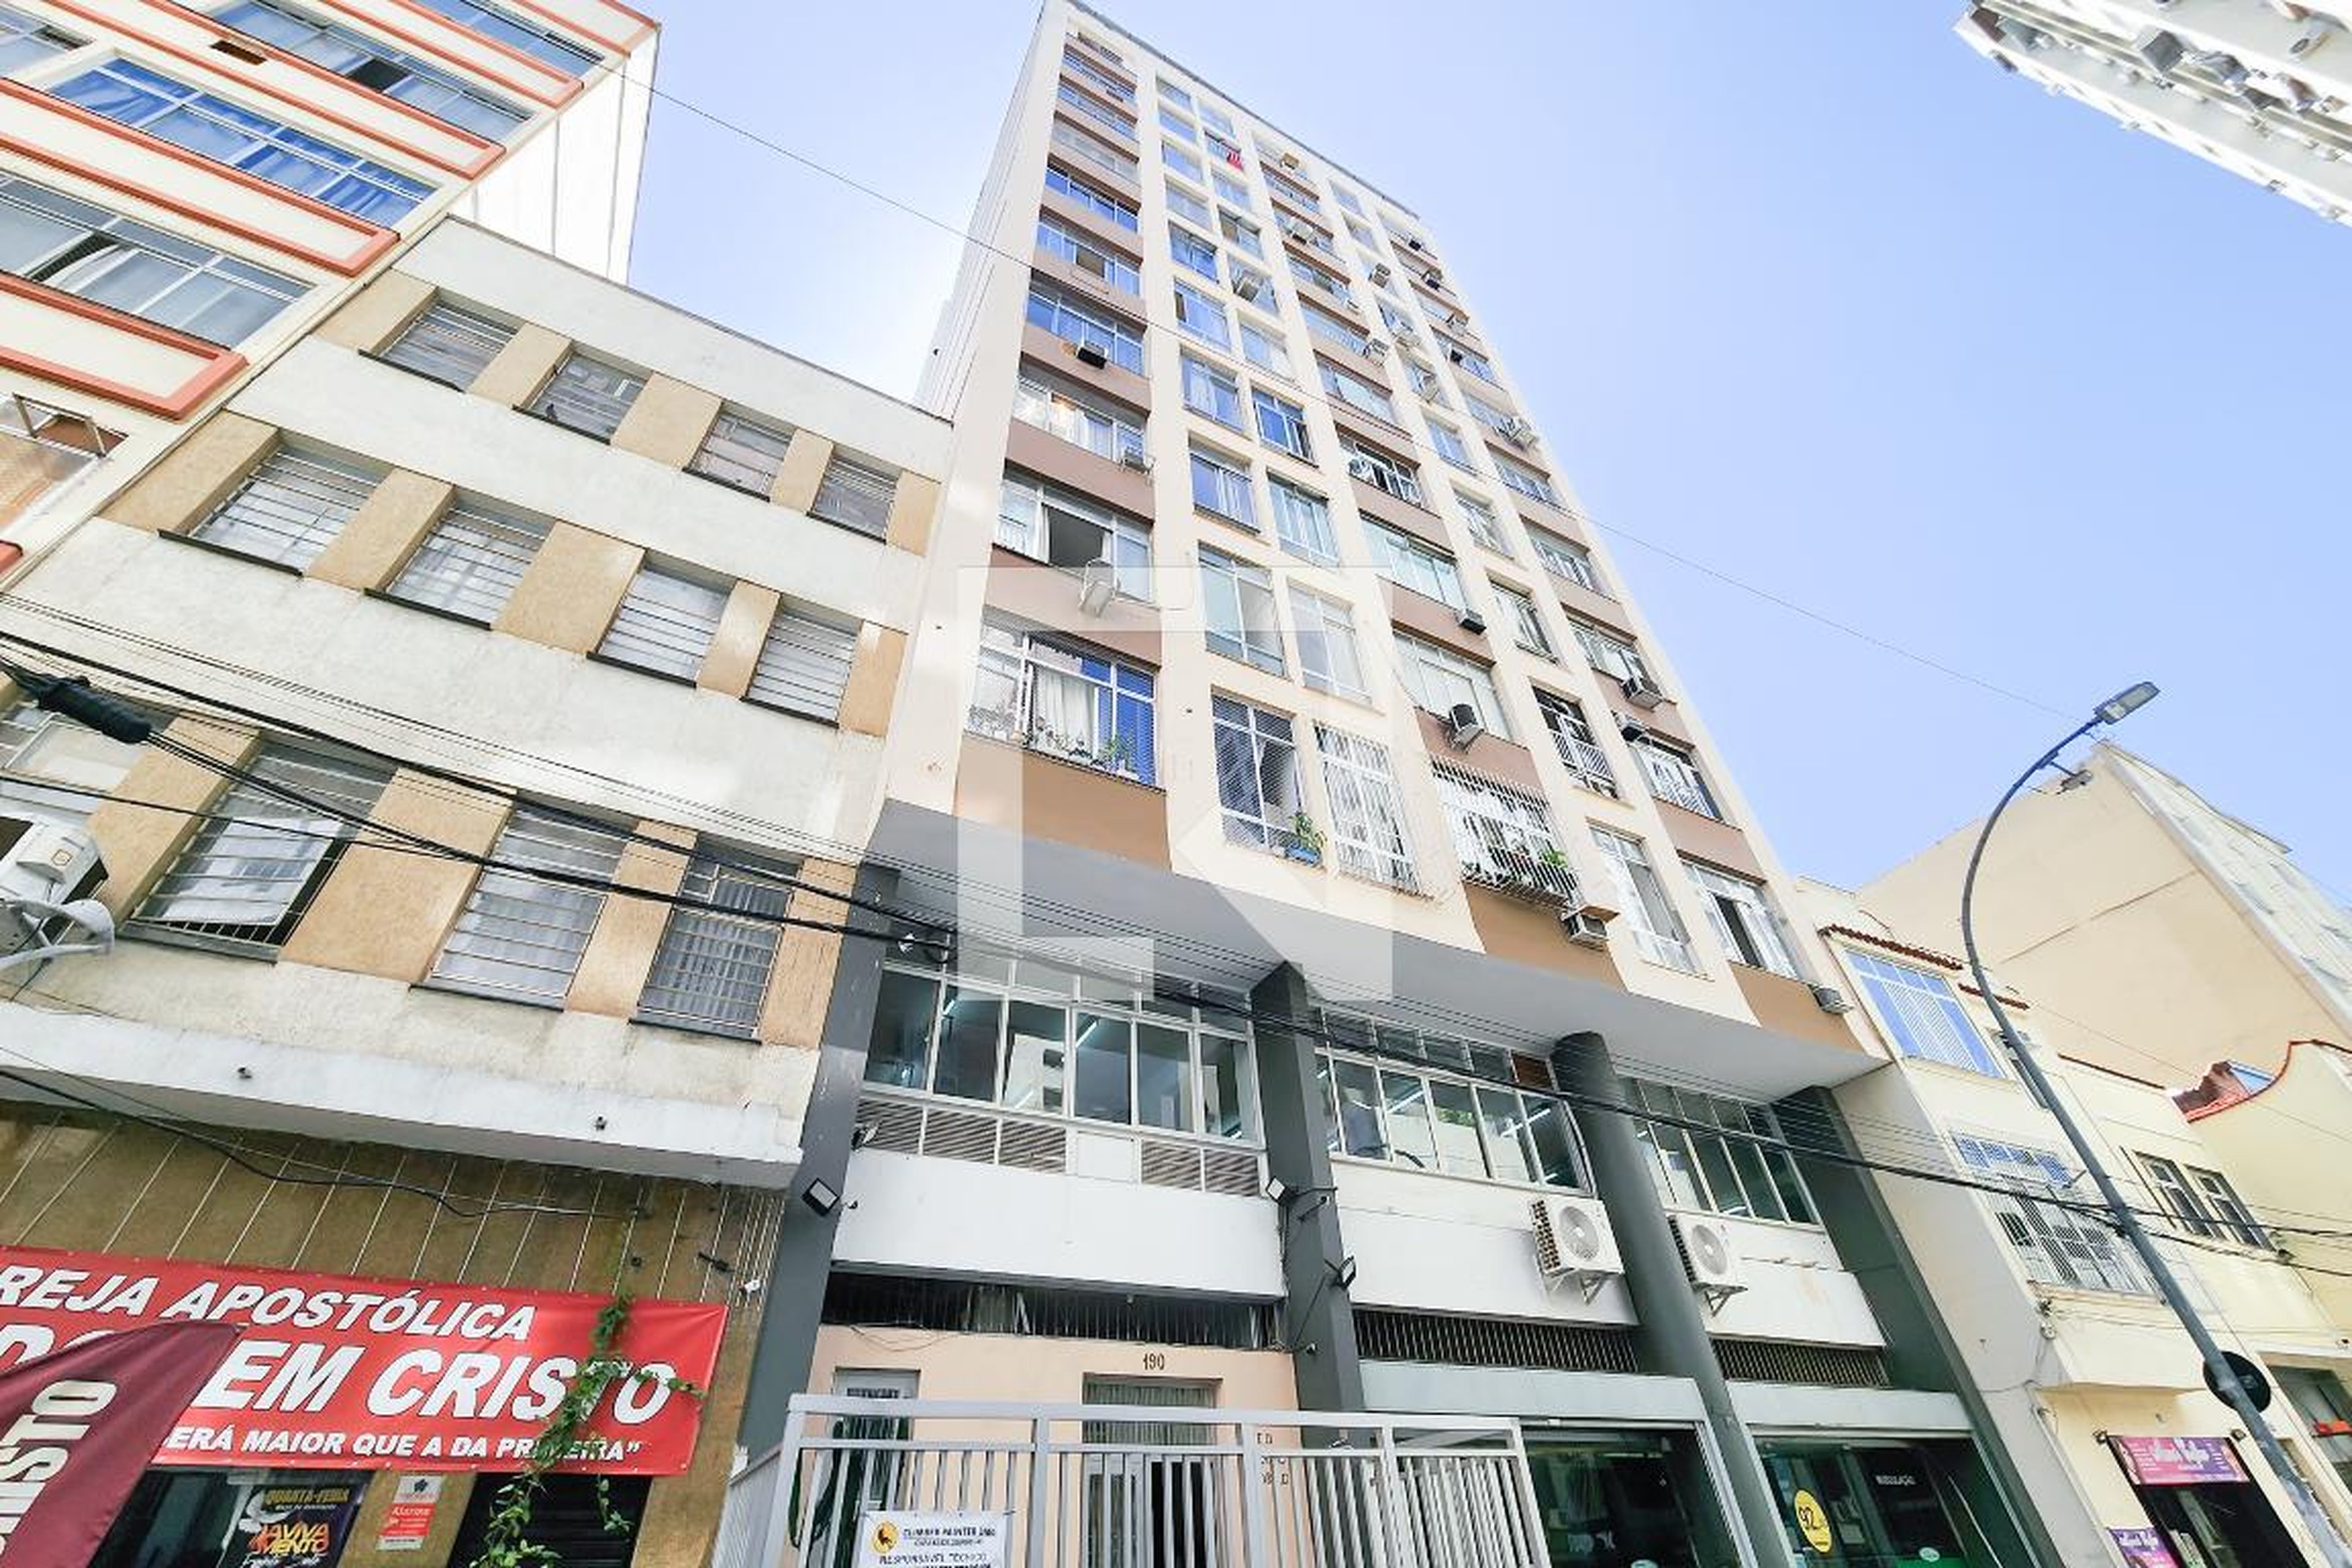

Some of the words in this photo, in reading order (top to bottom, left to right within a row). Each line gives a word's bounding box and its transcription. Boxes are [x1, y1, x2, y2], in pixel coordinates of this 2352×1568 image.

[159, 1281, 536, 1340] APOSTÓLICA
[190, 1340, 366, 1412] EM
[1143, 1353, 1164, 1370] 190
[162, 1424, 235, 1450] ERÁ
[241, 1430, 345, 1453] MAIOR
[353, 1433, 418, 1457] QUE
[420, 1436, 442, 1457] A
[450, 1437, 488, 1457] DA
